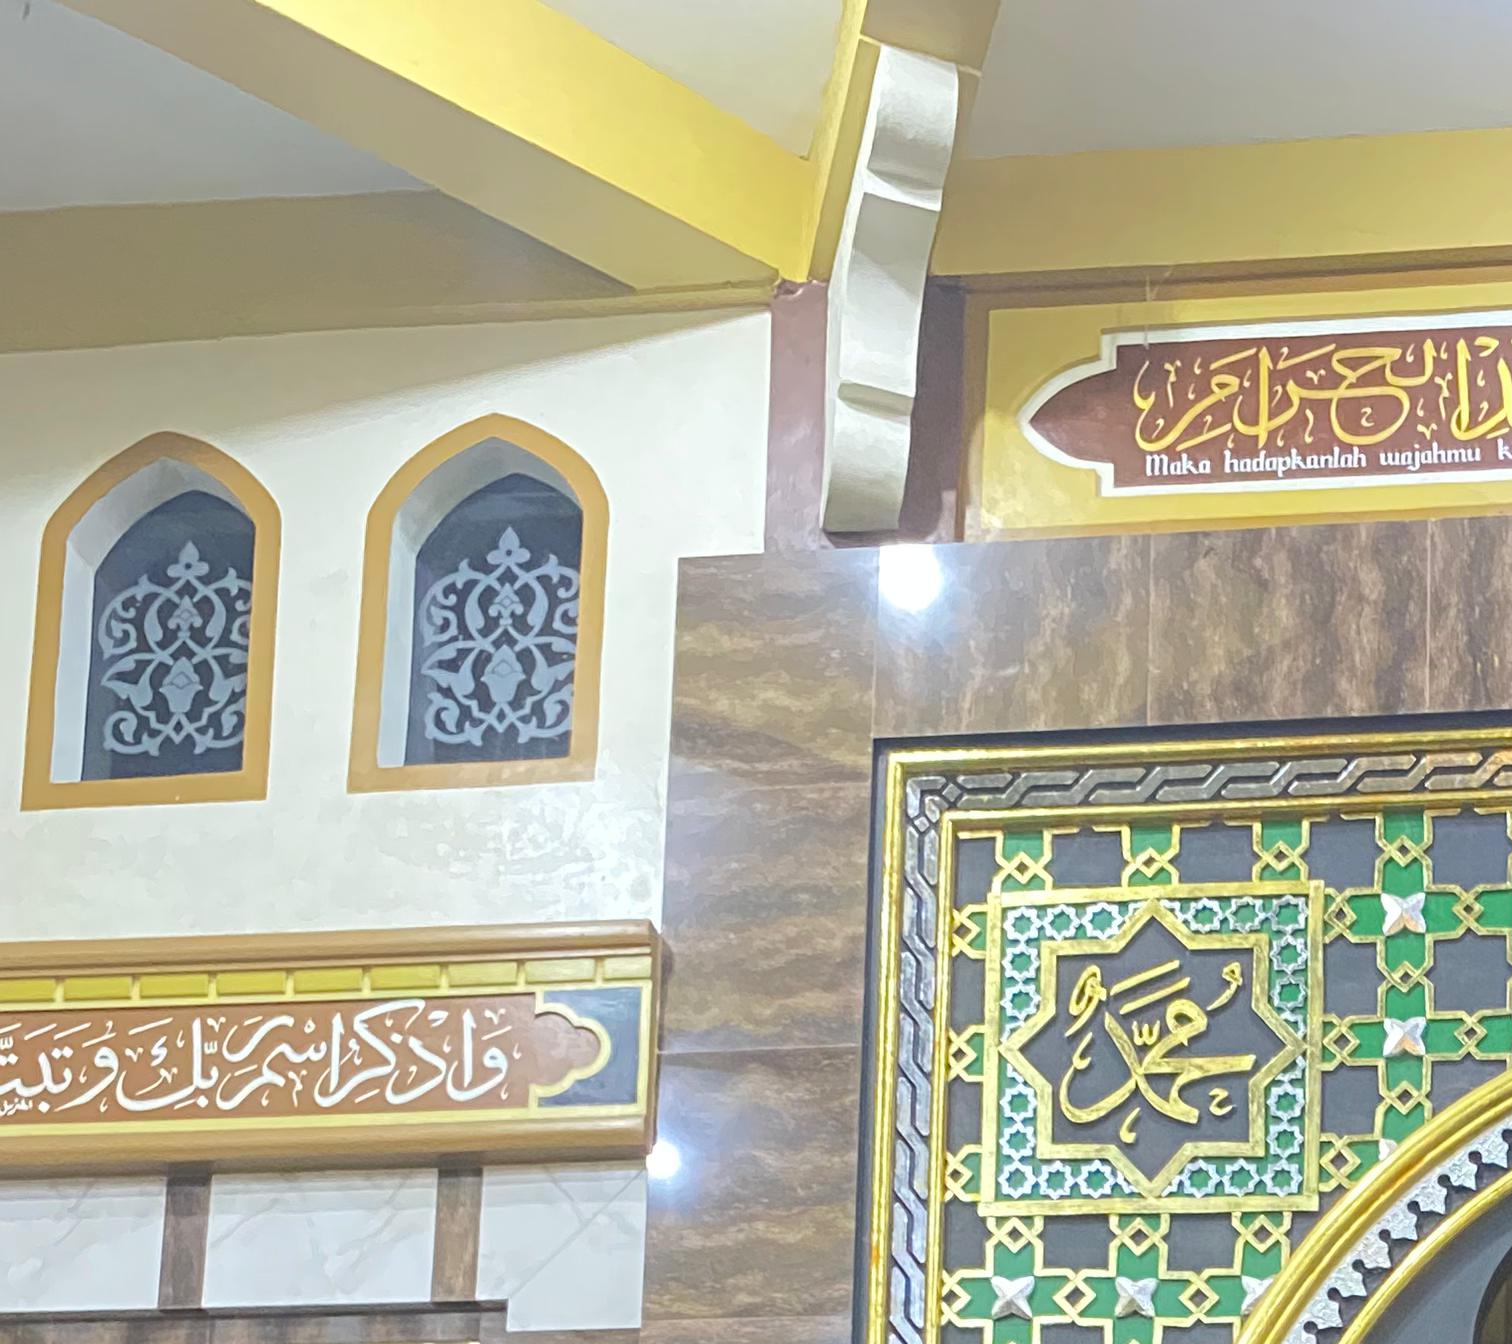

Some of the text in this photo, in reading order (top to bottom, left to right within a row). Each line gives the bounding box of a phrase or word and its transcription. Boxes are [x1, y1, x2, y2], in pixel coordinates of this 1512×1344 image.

[1145, 452, 1212, 476] Maka
[1223, 446, 1367, 477] hadapkanlah
[1379, 441, 1482, 471] wajahmu
